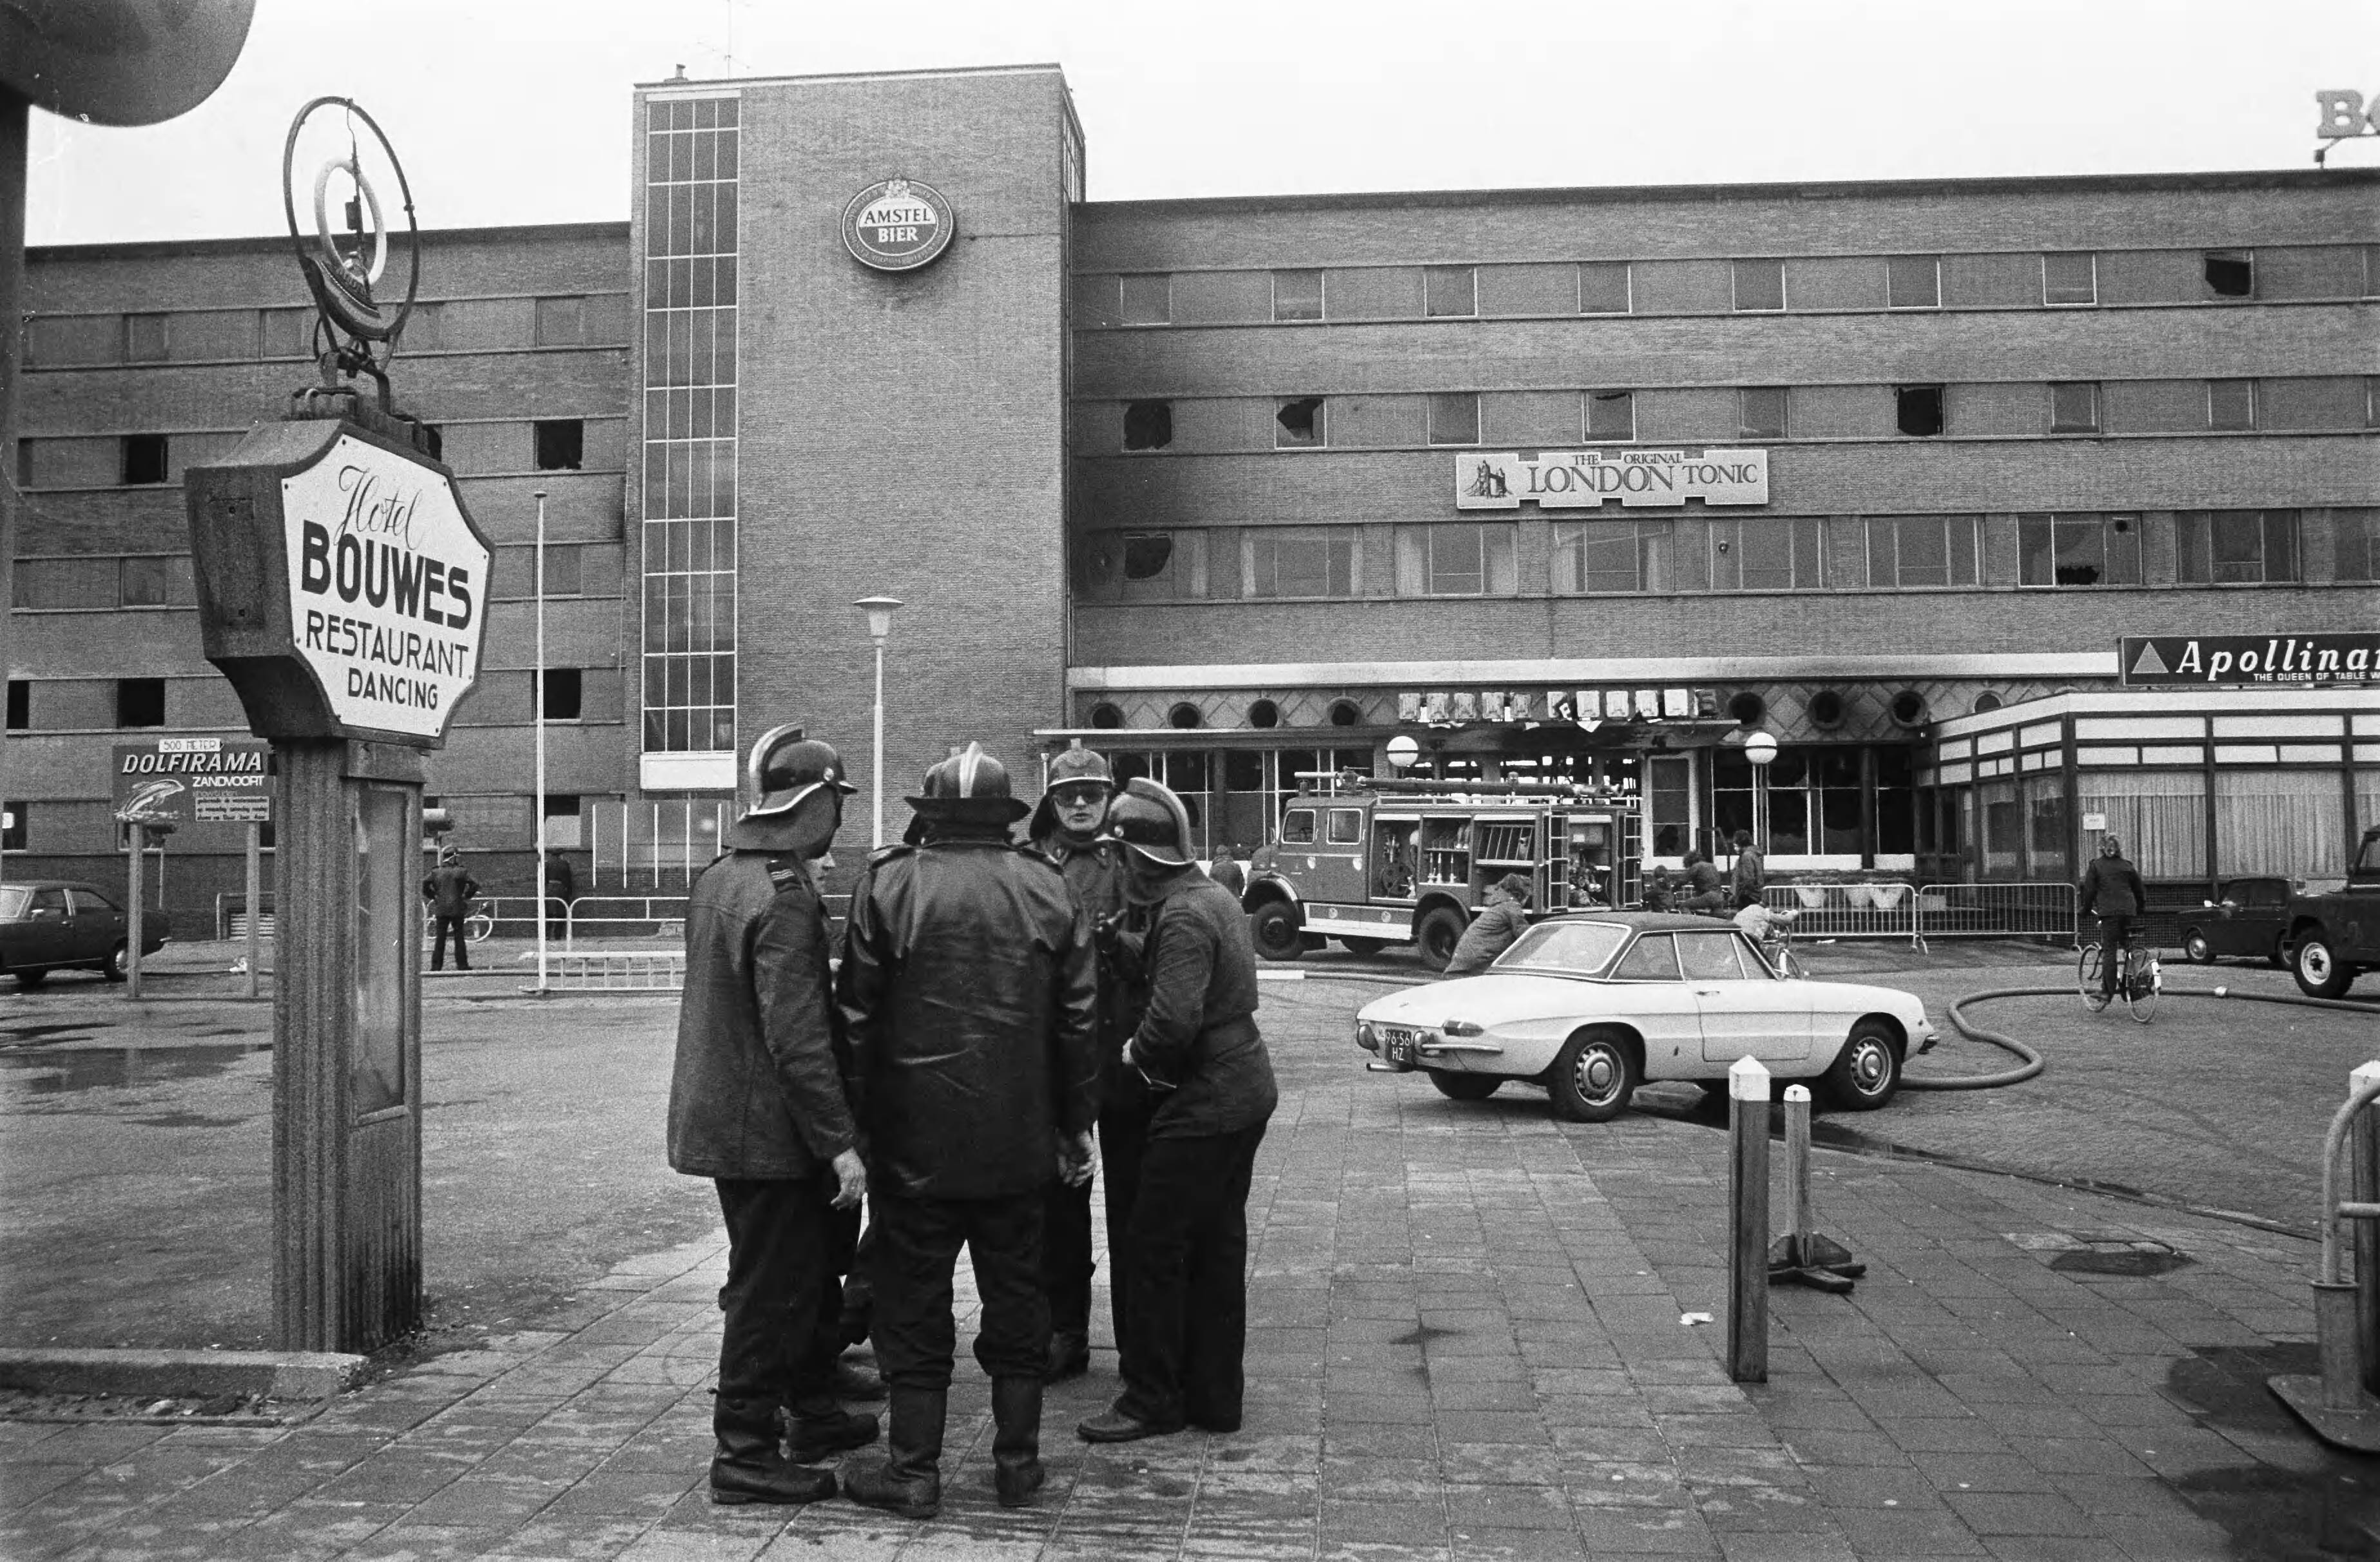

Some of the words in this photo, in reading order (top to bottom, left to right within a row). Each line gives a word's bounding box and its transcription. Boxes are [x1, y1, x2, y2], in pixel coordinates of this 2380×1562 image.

[2316, 89, 2380, 138] B
[864, 207, 931, 224] AMSTEL
[878, 226, 919, 243] BIER
[1572, 454, 1599, 466] THE
[1623, 452, 1683, 465] ORIGINAL
[1527, 465, 1675, 493] LONDON
[1681, 463, 1758, 485] TONIC
[334, 465, 423, 550] Hotel
[301, 519, 472, 630] BOUWES
[306, 610, 469, 679] RESTAURANT
[2254, 673, 2273, 681] THE
[2278, 673, 2312, 681] QUEEN
[2316, 672, 2330, 680] OF
[2334, 671, 2366, 680] TABLE
[347, 668, 439, 710] DANCING
[164, 741, 182, 751] 500
[122, 752, 261, 773] DOLFIRAMA
[193, 775, 265, 787] ZANDVOORT
[1392, 1047, 1404, 1061] HZ
